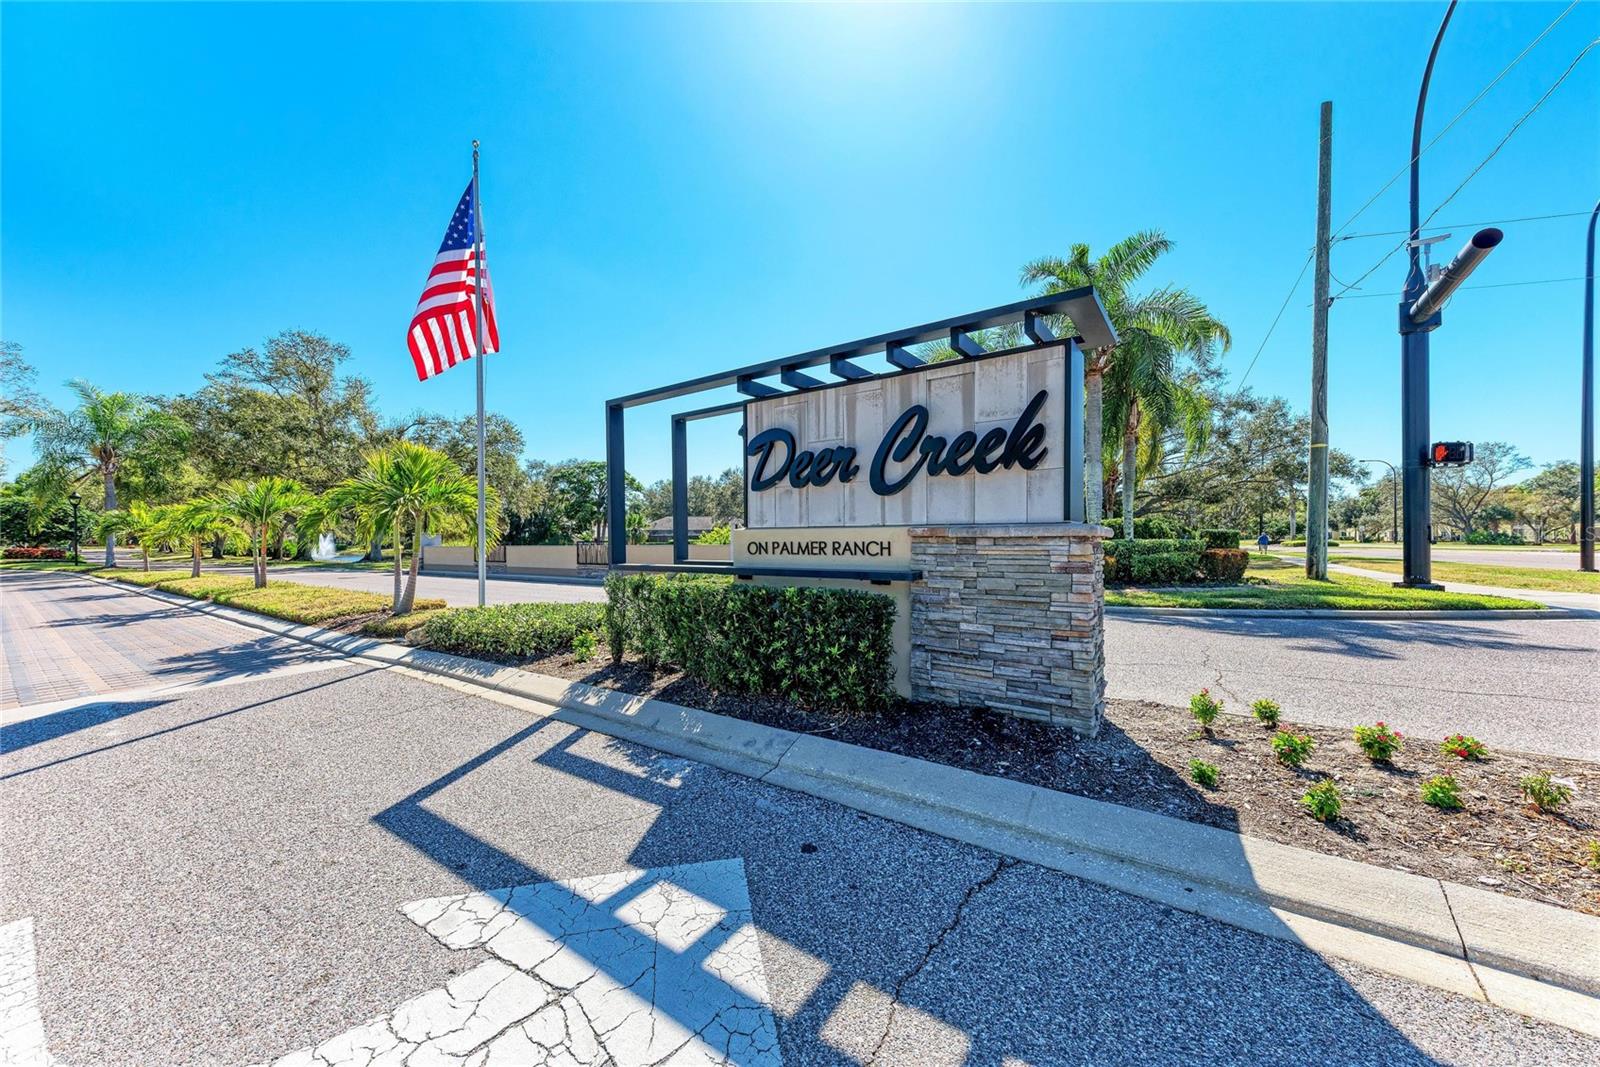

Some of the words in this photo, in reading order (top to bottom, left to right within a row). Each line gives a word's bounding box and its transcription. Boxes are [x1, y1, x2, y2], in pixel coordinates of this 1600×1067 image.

[747, 427, 860, 492] Deer
[869, 389, 1048, 497] Creek
[747, 541, 769, 556] ON
[771, 541, 828, 556] PALMER
[832, 540, 892, 557] RANCH
